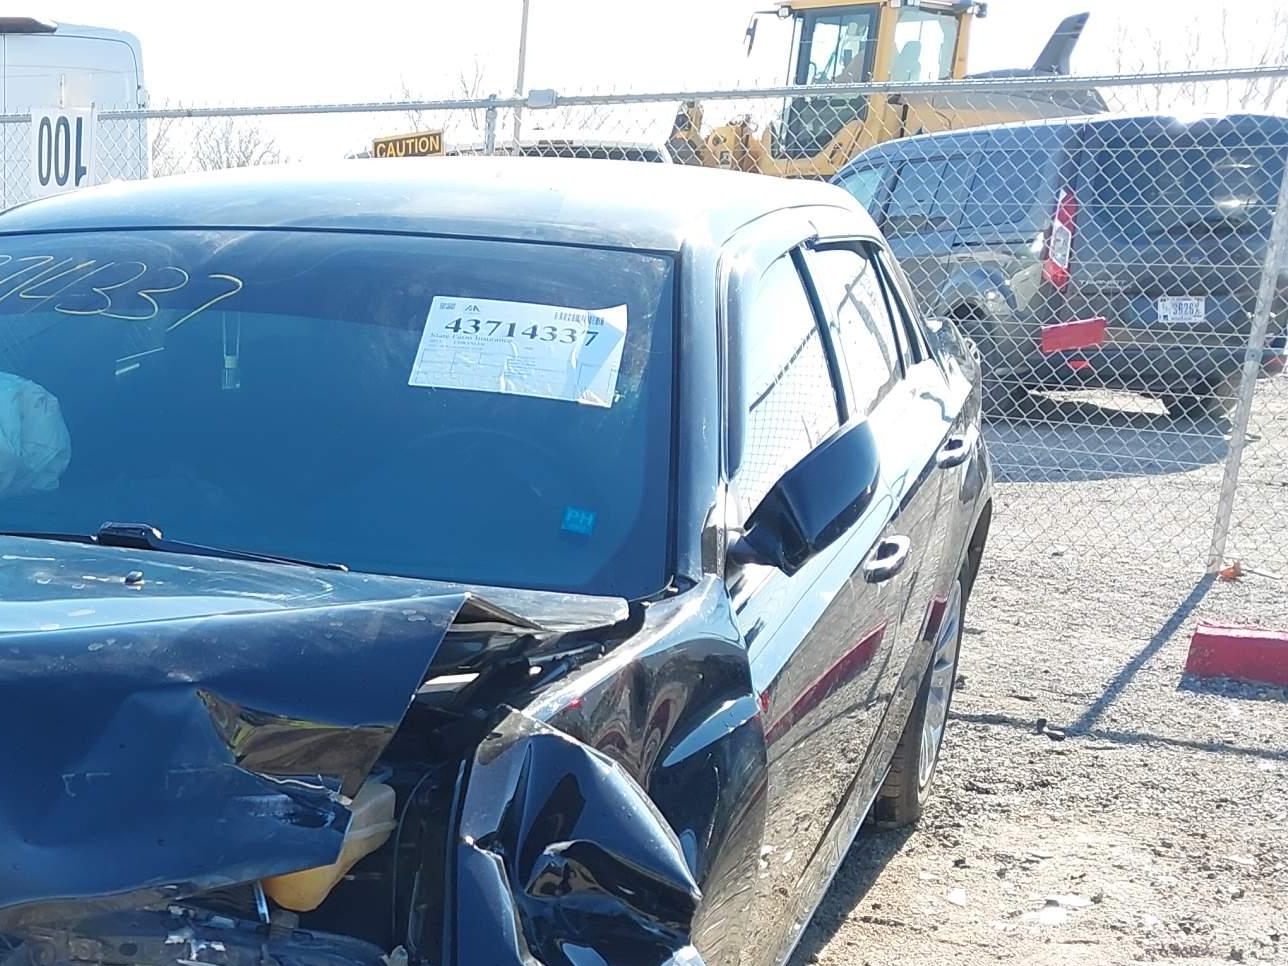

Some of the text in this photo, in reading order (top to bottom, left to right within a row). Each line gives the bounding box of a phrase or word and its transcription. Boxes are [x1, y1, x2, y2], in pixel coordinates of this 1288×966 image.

[37, 115, 87, 187] 100
[375, 135, 440, 158] CAUTION
[444, 317, 600, 347] 43714337
